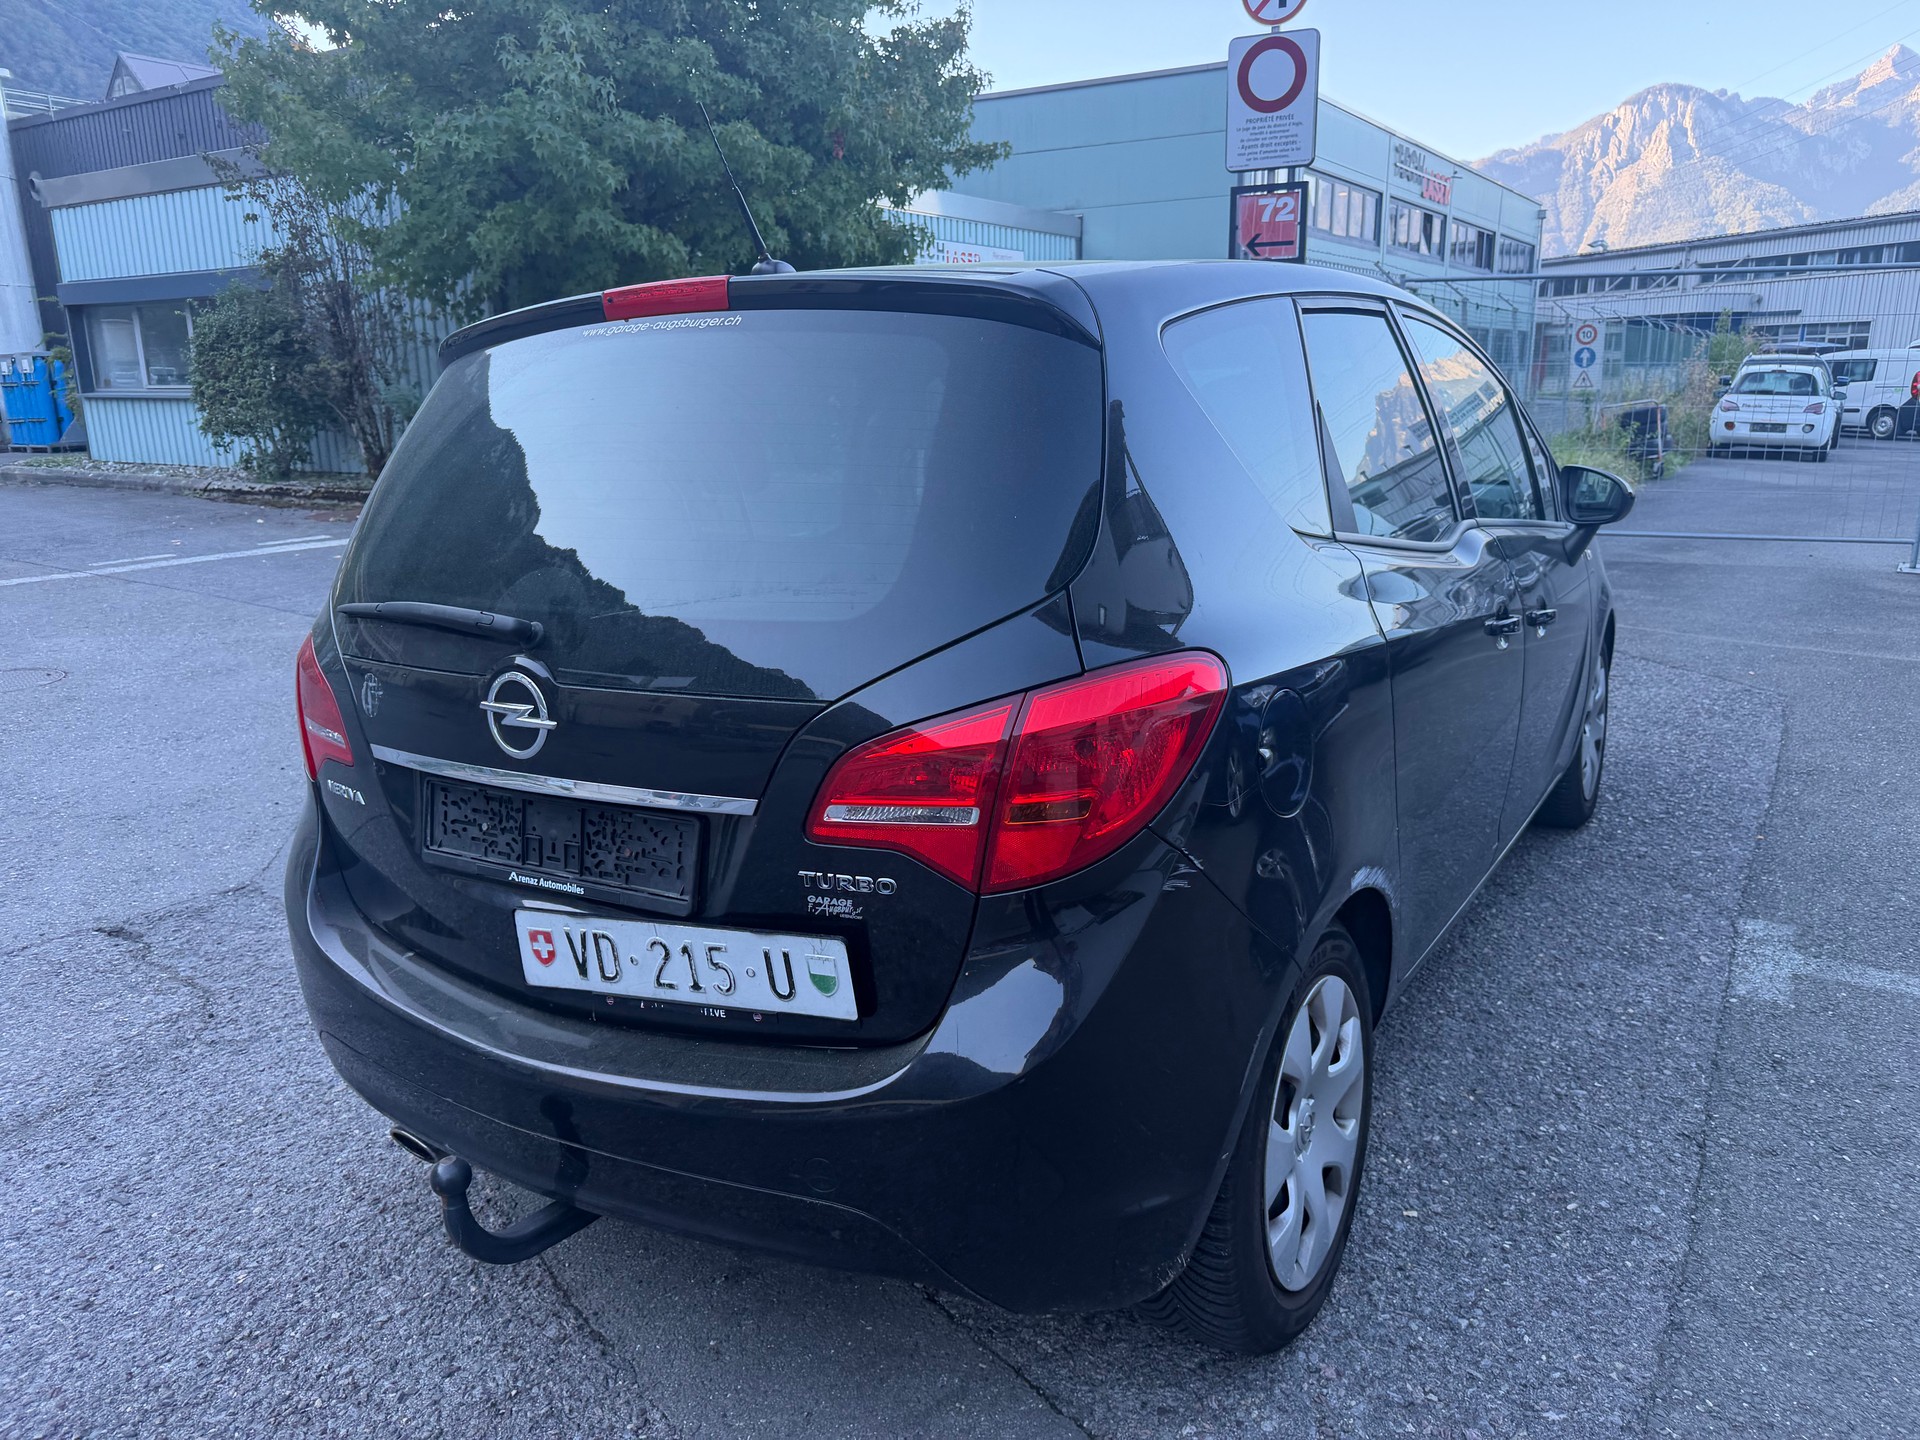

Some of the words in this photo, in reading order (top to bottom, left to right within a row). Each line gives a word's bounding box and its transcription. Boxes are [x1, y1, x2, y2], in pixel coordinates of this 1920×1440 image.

[1246, 116, 1274, 124] PROPRIÉTÉ
[1276, 113, 1294, 121] PRIVÉE
[1258, 196, 1295, 222] 72
[582, 314, 742, 337] www.garage-augsburger.ch
[1582, 330, 1592, 339] 10
[509, 872, 538, 886] Arenaz
[538, 877, 585, 895] Automobiles
[798, 870, 898, 895] TURBO
[807, 895, 853, 907] GARAGE
[563, 926, 622, 984] VD
[645, 936, 736, 996] 215
[762, 946, 798, 1002] U
